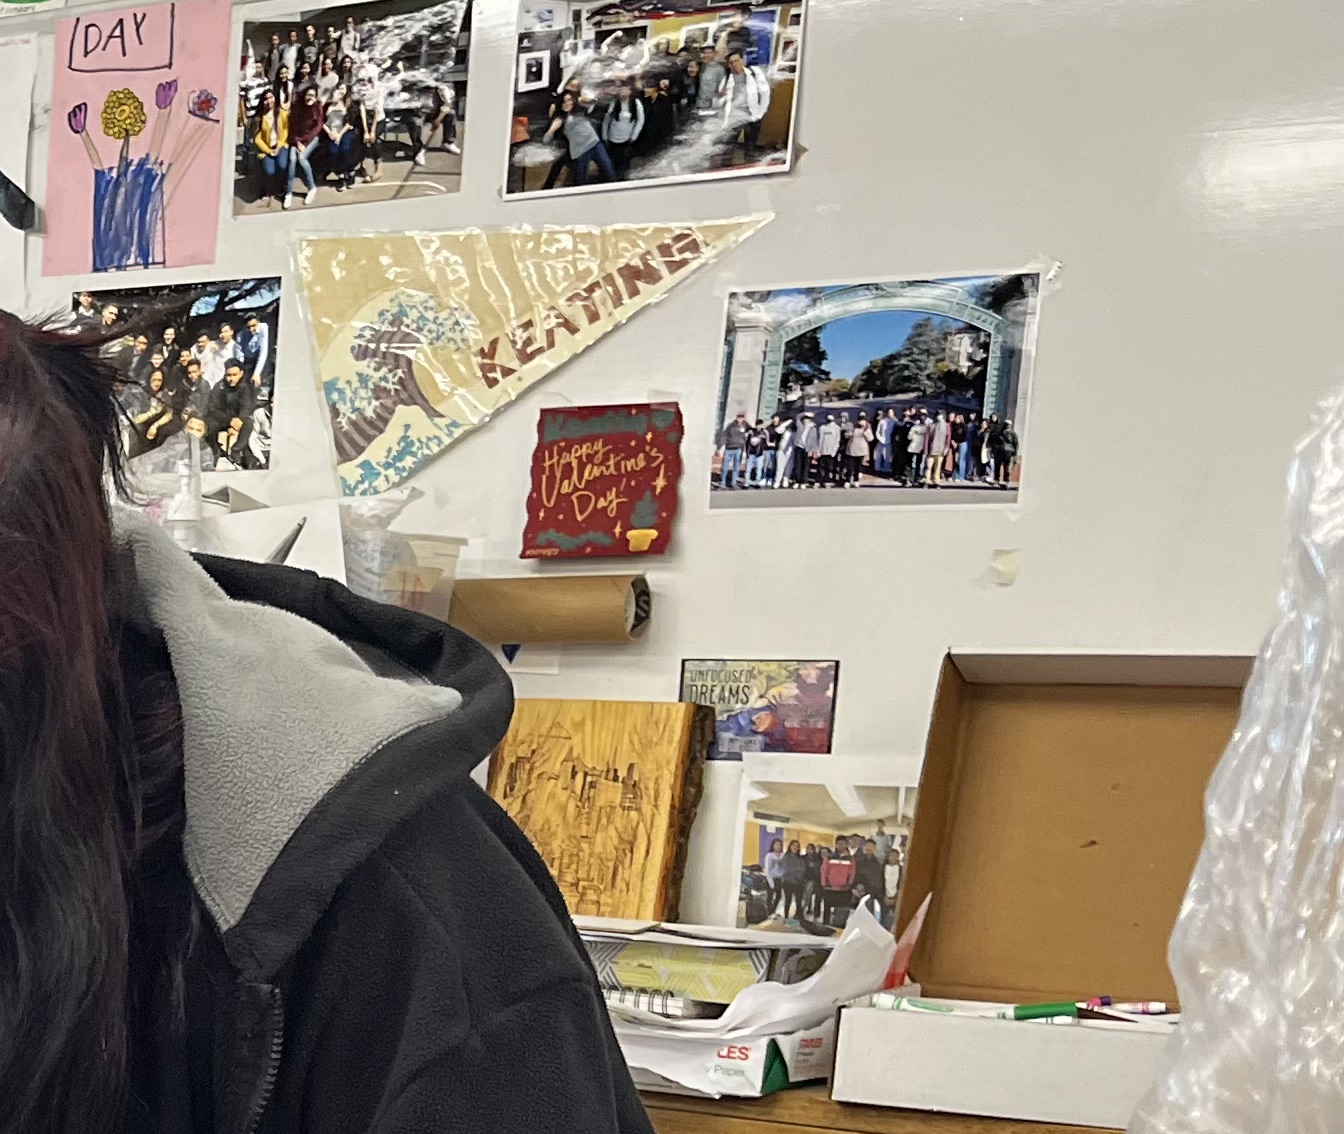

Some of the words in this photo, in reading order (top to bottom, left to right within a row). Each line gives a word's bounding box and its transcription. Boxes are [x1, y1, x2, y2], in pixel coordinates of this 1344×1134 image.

[83, 12, 149, 58] DAY
[479, 227, 706, 389] KEATING
[541, 445, 664, 508] Valentine's
[543, 438, 614, 477] Happy
[690, 684, 750, 706] DREAMS
